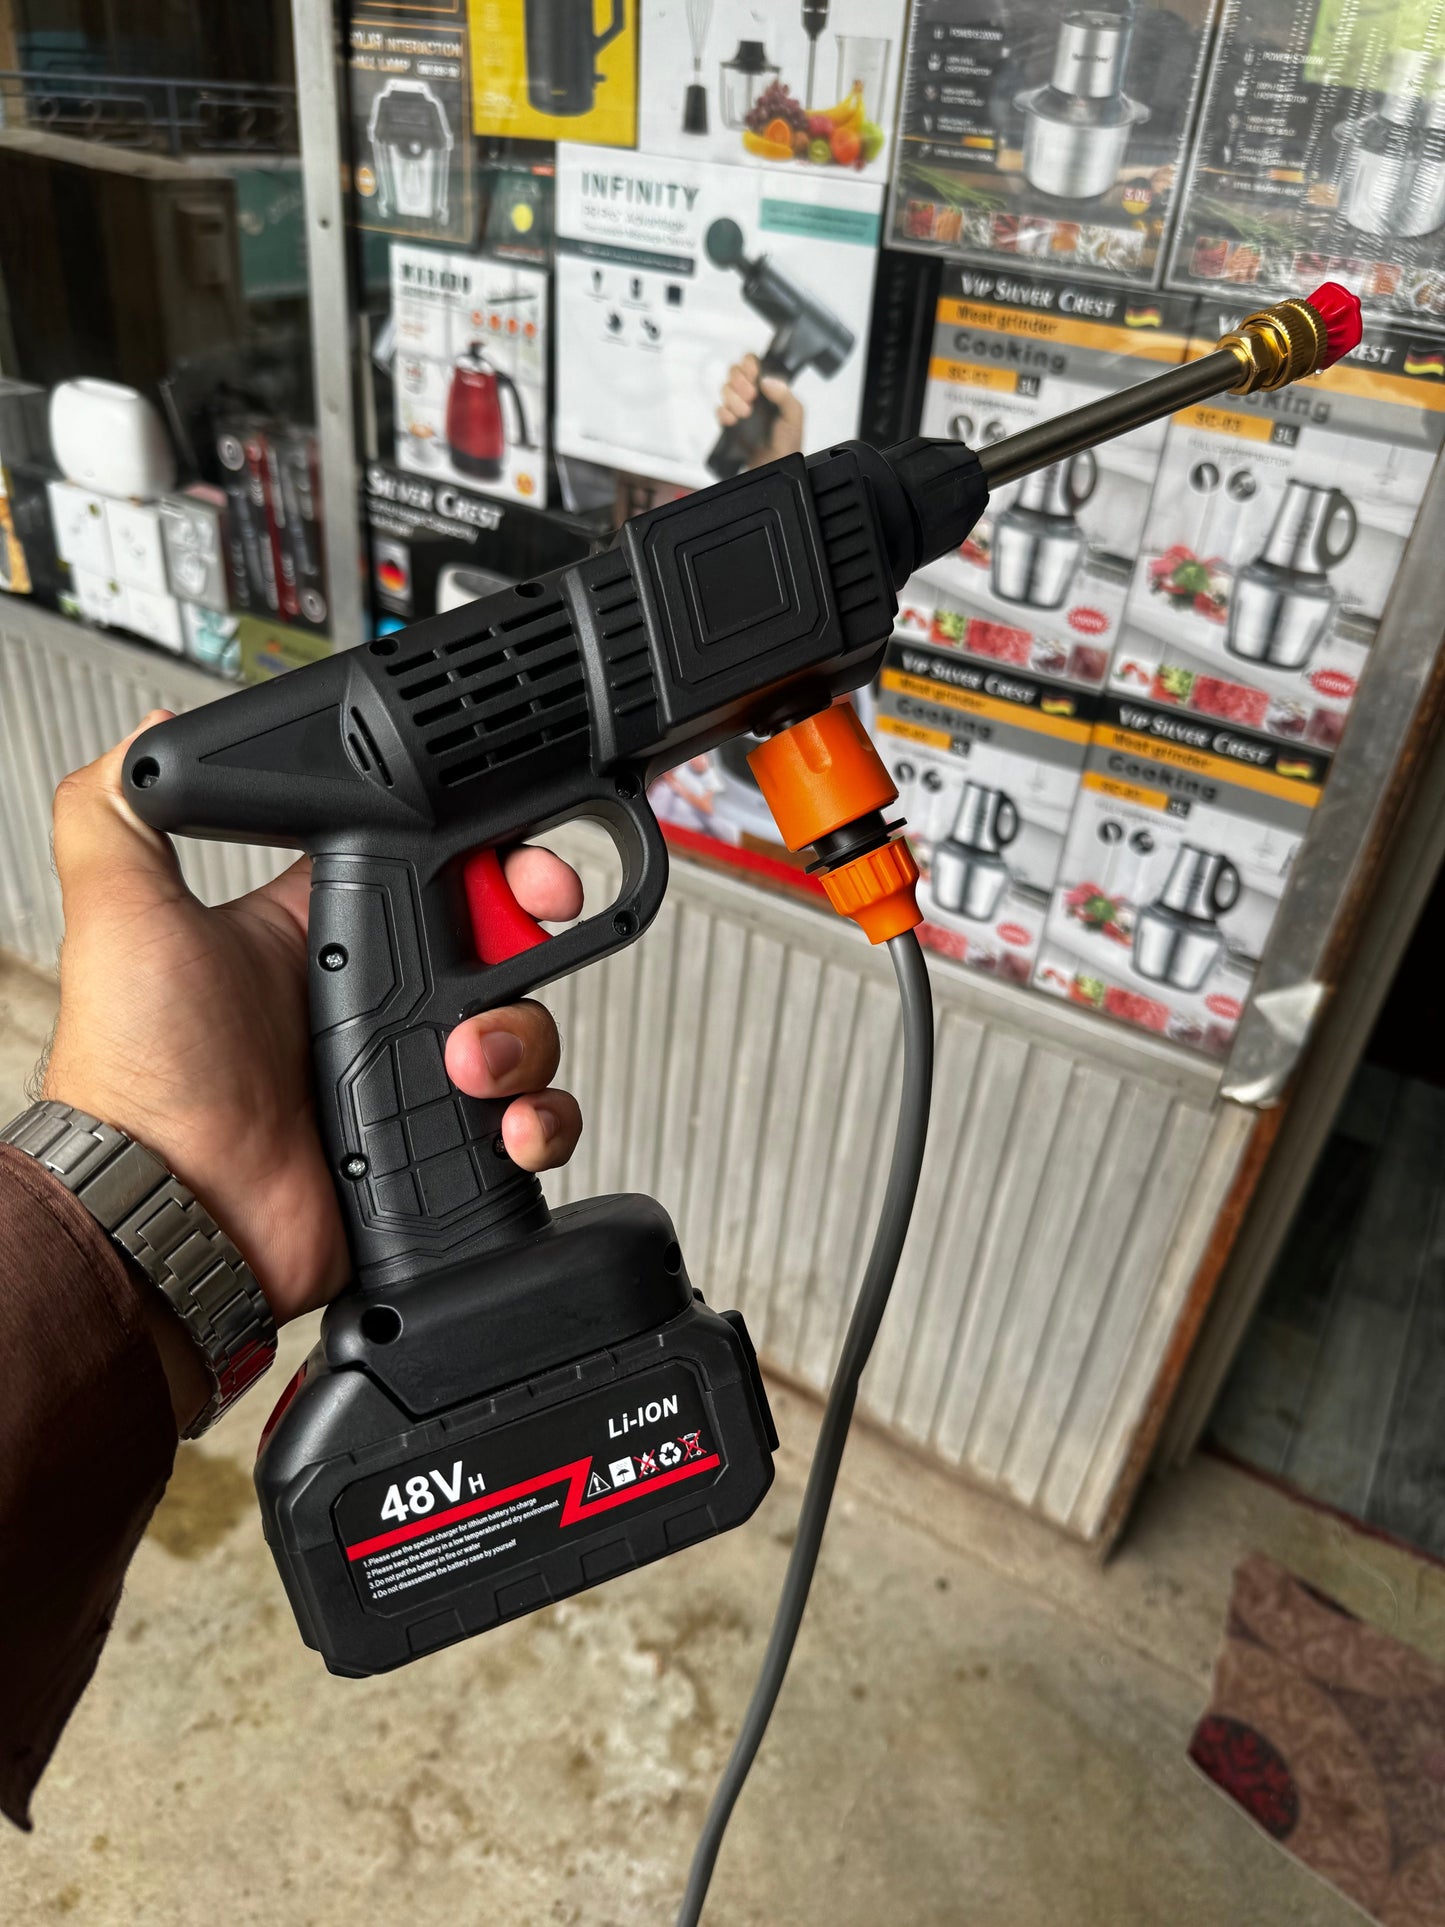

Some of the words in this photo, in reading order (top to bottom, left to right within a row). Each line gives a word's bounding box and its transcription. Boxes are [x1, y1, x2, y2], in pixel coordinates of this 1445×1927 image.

[581, 170, 701, 212] INFINITY
[957, 304, 996, 325] Meat
[998, 310, 1057, 336] grinder
[993, 278, 1055, 309] SILVER
[1058, 286, 1119, 319] CREST
[953, 331, 1068, 375] Cooking
[1349, 344, 1396, 365] REST
[366, 467, 434, 512] SILVER
[434, 484, 505, 531] CREST
[929, 658, 985, 690] SILVER
[984, 673, 1039, 704] CREST
[896, 699, 992, 741] Cooking
[1150, 714, 1211, 748] SILVER
[1212, 731, 1272, 765] CREST
[1112, 731, 1148, 753] Meat
[1150, 744, 1213, 769] grinder
[1107, 754, 1217, 801] Cooking
[608, 1395, 678, 1439] Li-ION
[380, 1460, 463, 1522] 48V
[468, 1473, 486, 1495] H
[390, 1548, 403, 1558] use
[402, 1544, 413, 1555] the
[413, 1535, 435, 1550] special
[435, 1527, 459, 1541] charger
[458, 1523, 468, 1532] for
[467, 1516, 488, 1529] lithium
[488, 1508, 509, 1521] battery
[516, 1498, 537, 1510] charge
[393, 1558, 410, 1570] keep
[409, 1553, 420, 1562] the
[419, 1546, 442, 1559] battery
[452, 1537, 464, 1545] low
[463, 1523, 501, 1542] temperature
[500, 1518, 513, 1528] and
[512, 1514, 523, 1524] dry
[522, 1499, 559, 1519] environment
[384, 1573, 396, 1583] not
[395, 1569, 407, 1580] put
[406, 1565, 417, 1575] the
[417, 1558, 439, 1571] battery
[438, 1555, 446, 1563] in
[445, 1551, 456, 1560] fire
[463, 1542, 481, 1553] water
[387, 1584, 399, 1594] not
[398, 1569, 437, 1590] disassemble
[436, 1565, 448, 1575] the
[447, 1558, 469, 1572] battery
[469, 1552, 484, 1563] case
[484, 1549, 493, 1558] by
[493, 1538, 517, 1555] yourself
